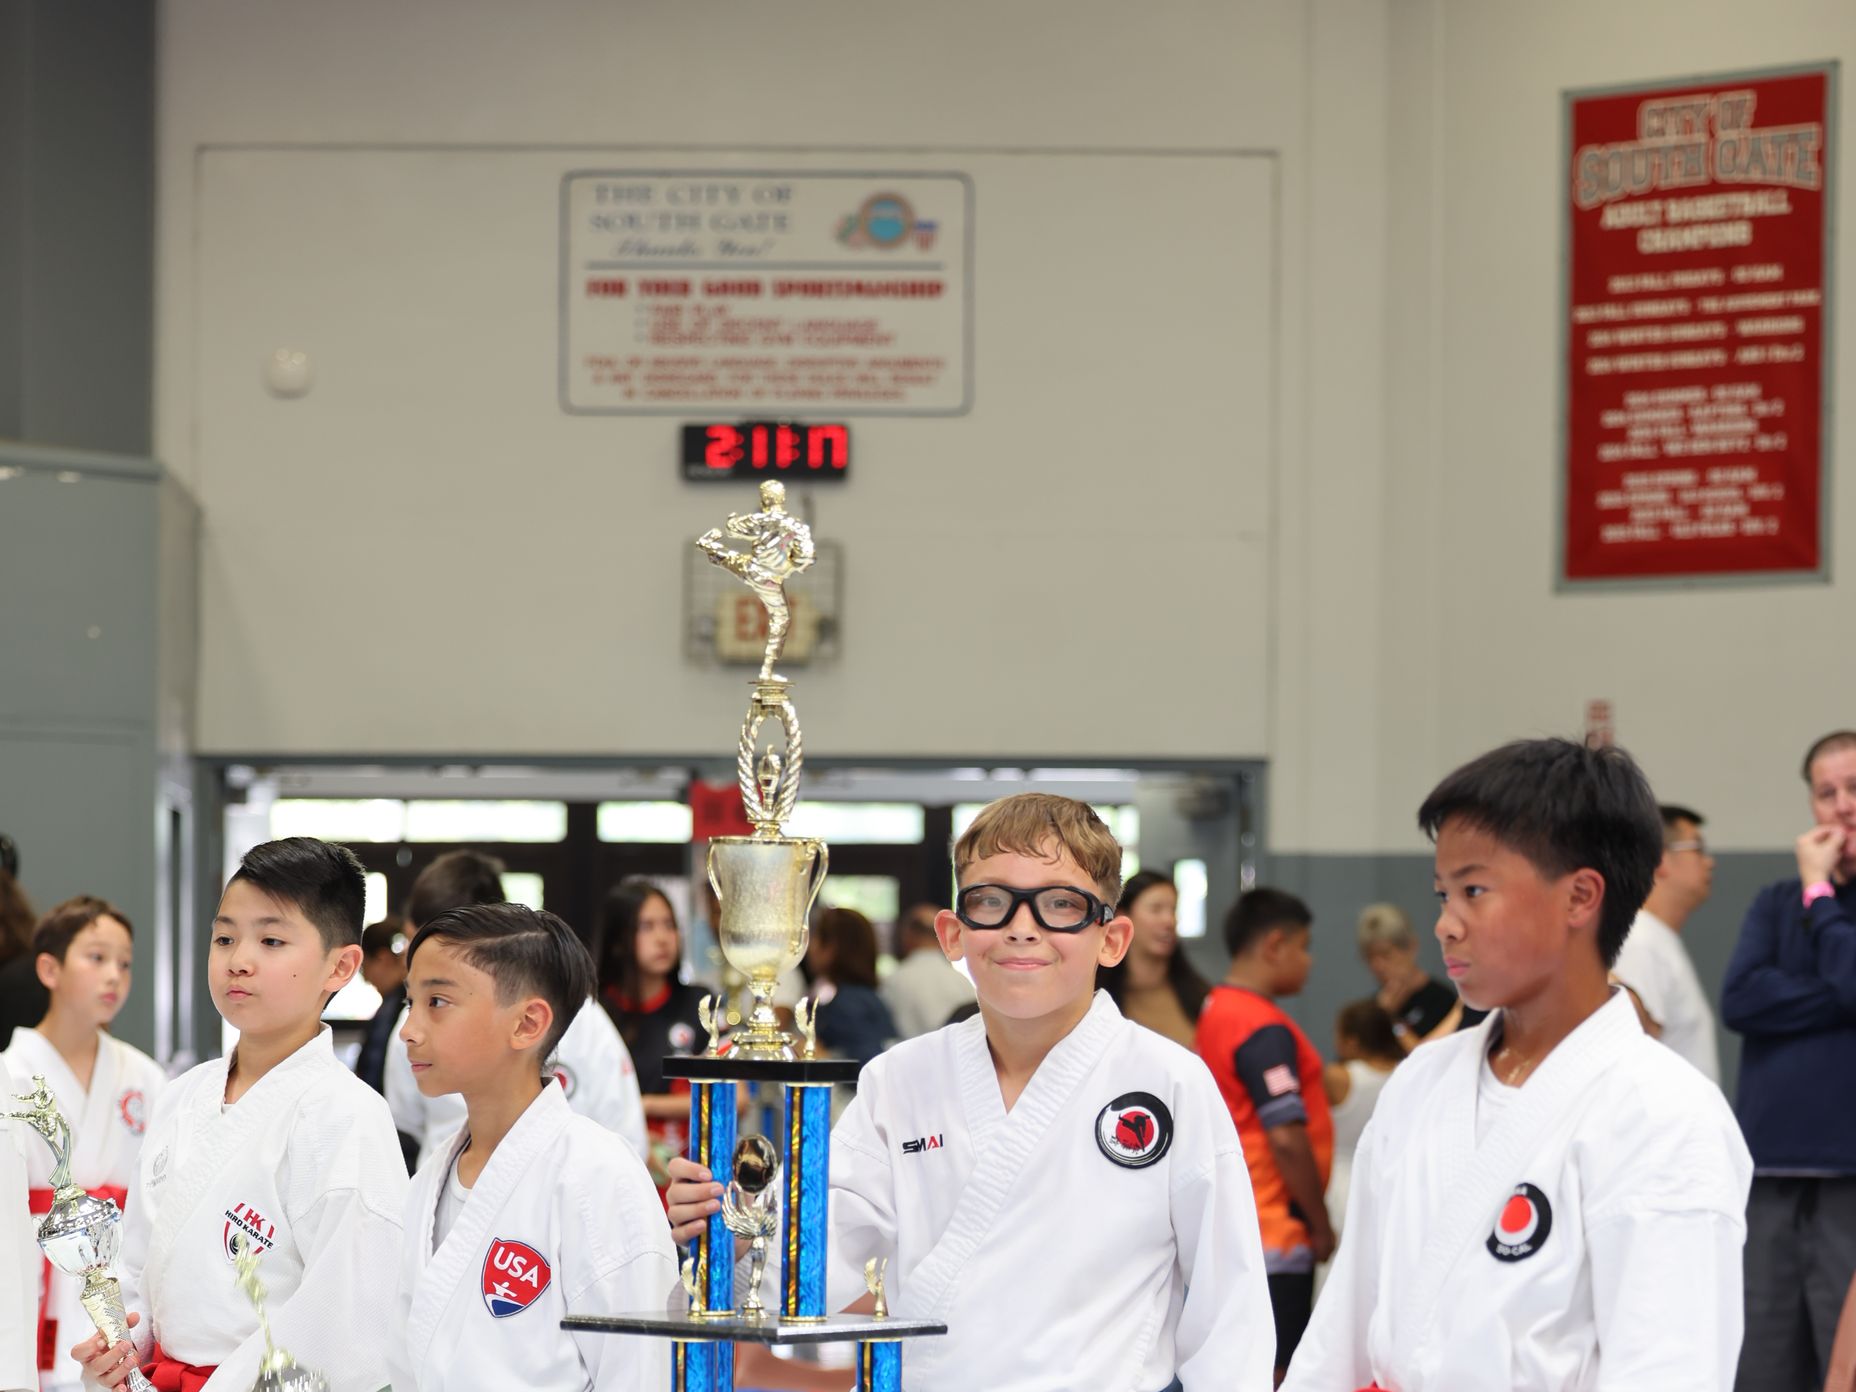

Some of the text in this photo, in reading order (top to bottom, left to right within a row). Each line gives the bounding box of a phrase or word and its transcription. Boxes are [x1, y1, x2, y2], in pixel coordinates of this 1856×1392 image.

[1638, 93, 1713, 140] CITY
[1575, 122, 1821, 210] SOUTH GATE
[591, 184, 796, 205] THE CITY OF
[1666, 189, 1791, 223] BASKETBALL
[589, 211, 794, 233] SOUTH GATE
[1638, 220, 1752, 254] CHAMPIONS
[585, 276, 946, 299] FOR YOUR GOOD SPORTSMANSHIP
[902, 1133, 943, 1154] SMAI
[225, 1210, 274, 1249] HIRO KARATE
[243, 1208, 266, 1231] HK
[493, 1246, 539, 1288] USA
